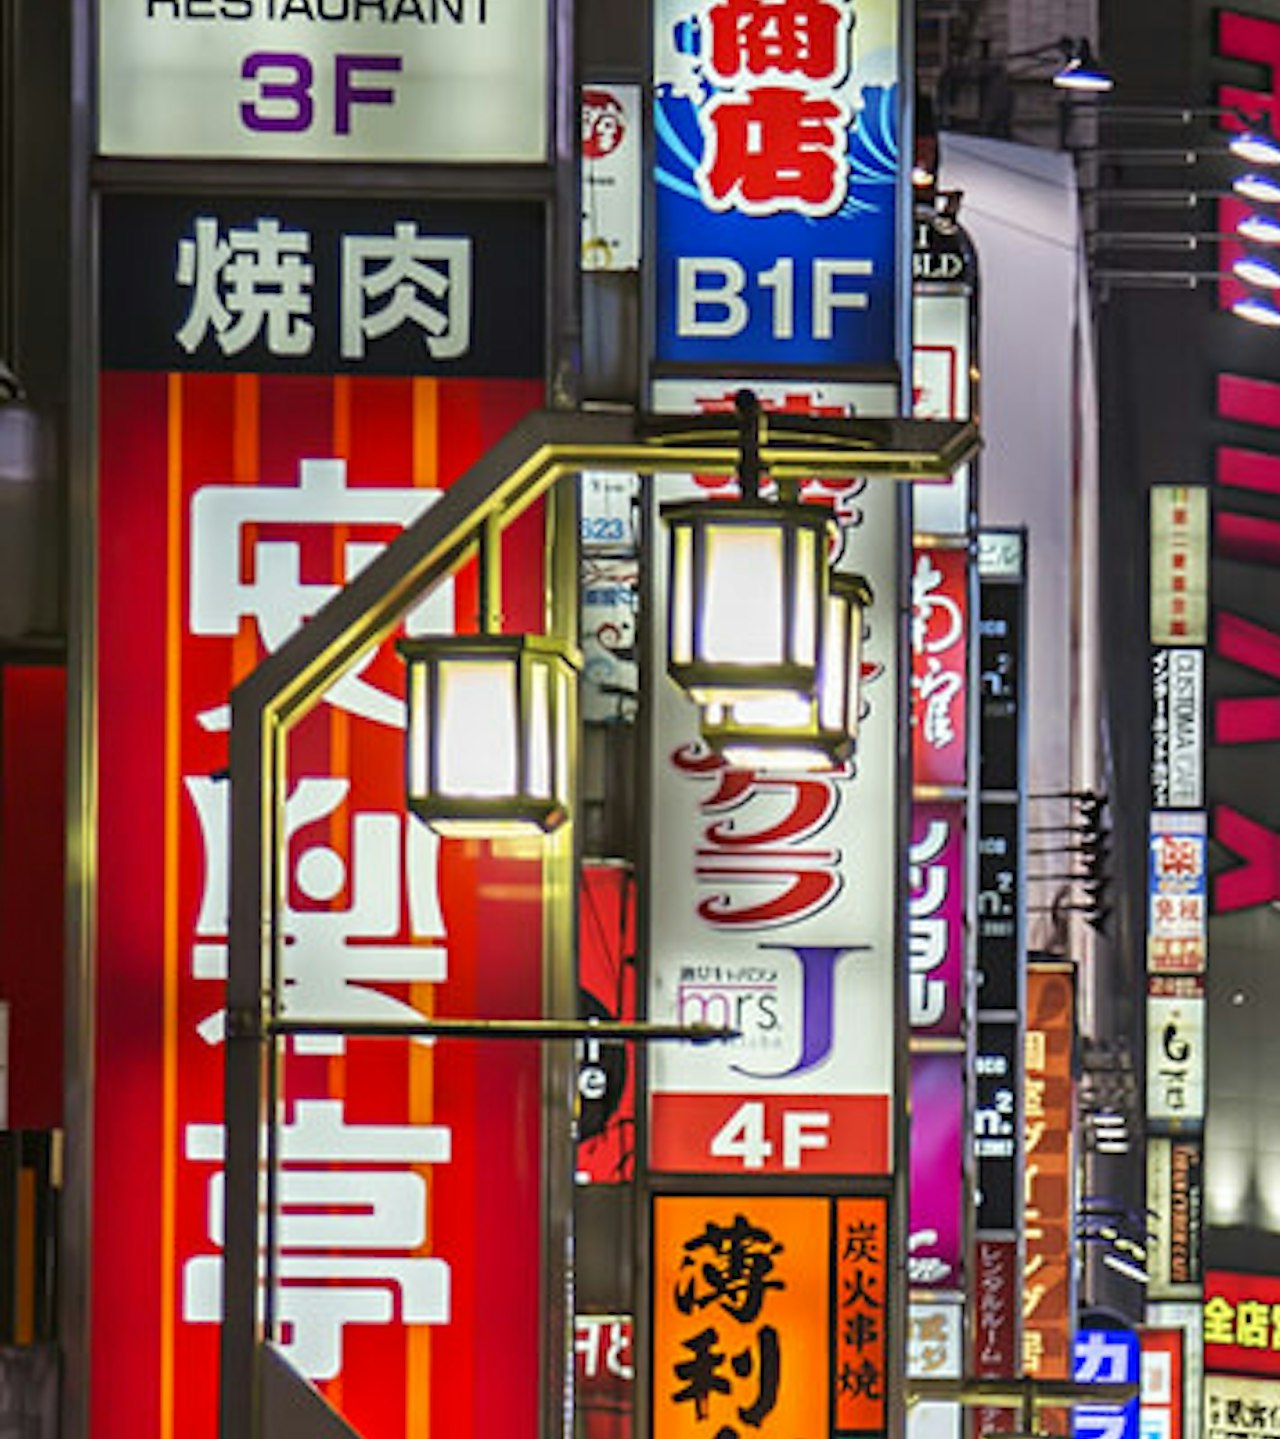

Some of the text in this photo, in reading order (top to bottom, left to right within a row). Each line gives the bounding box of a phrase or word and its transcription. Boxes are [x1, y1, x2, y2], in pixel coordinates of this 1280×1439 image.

[239, 52, 402, 136] 3F
[175, 220, 474, 358] 焼肉
[676, 258, 872, 340] B1F
[712, 1104, 832, 1168] 4F
